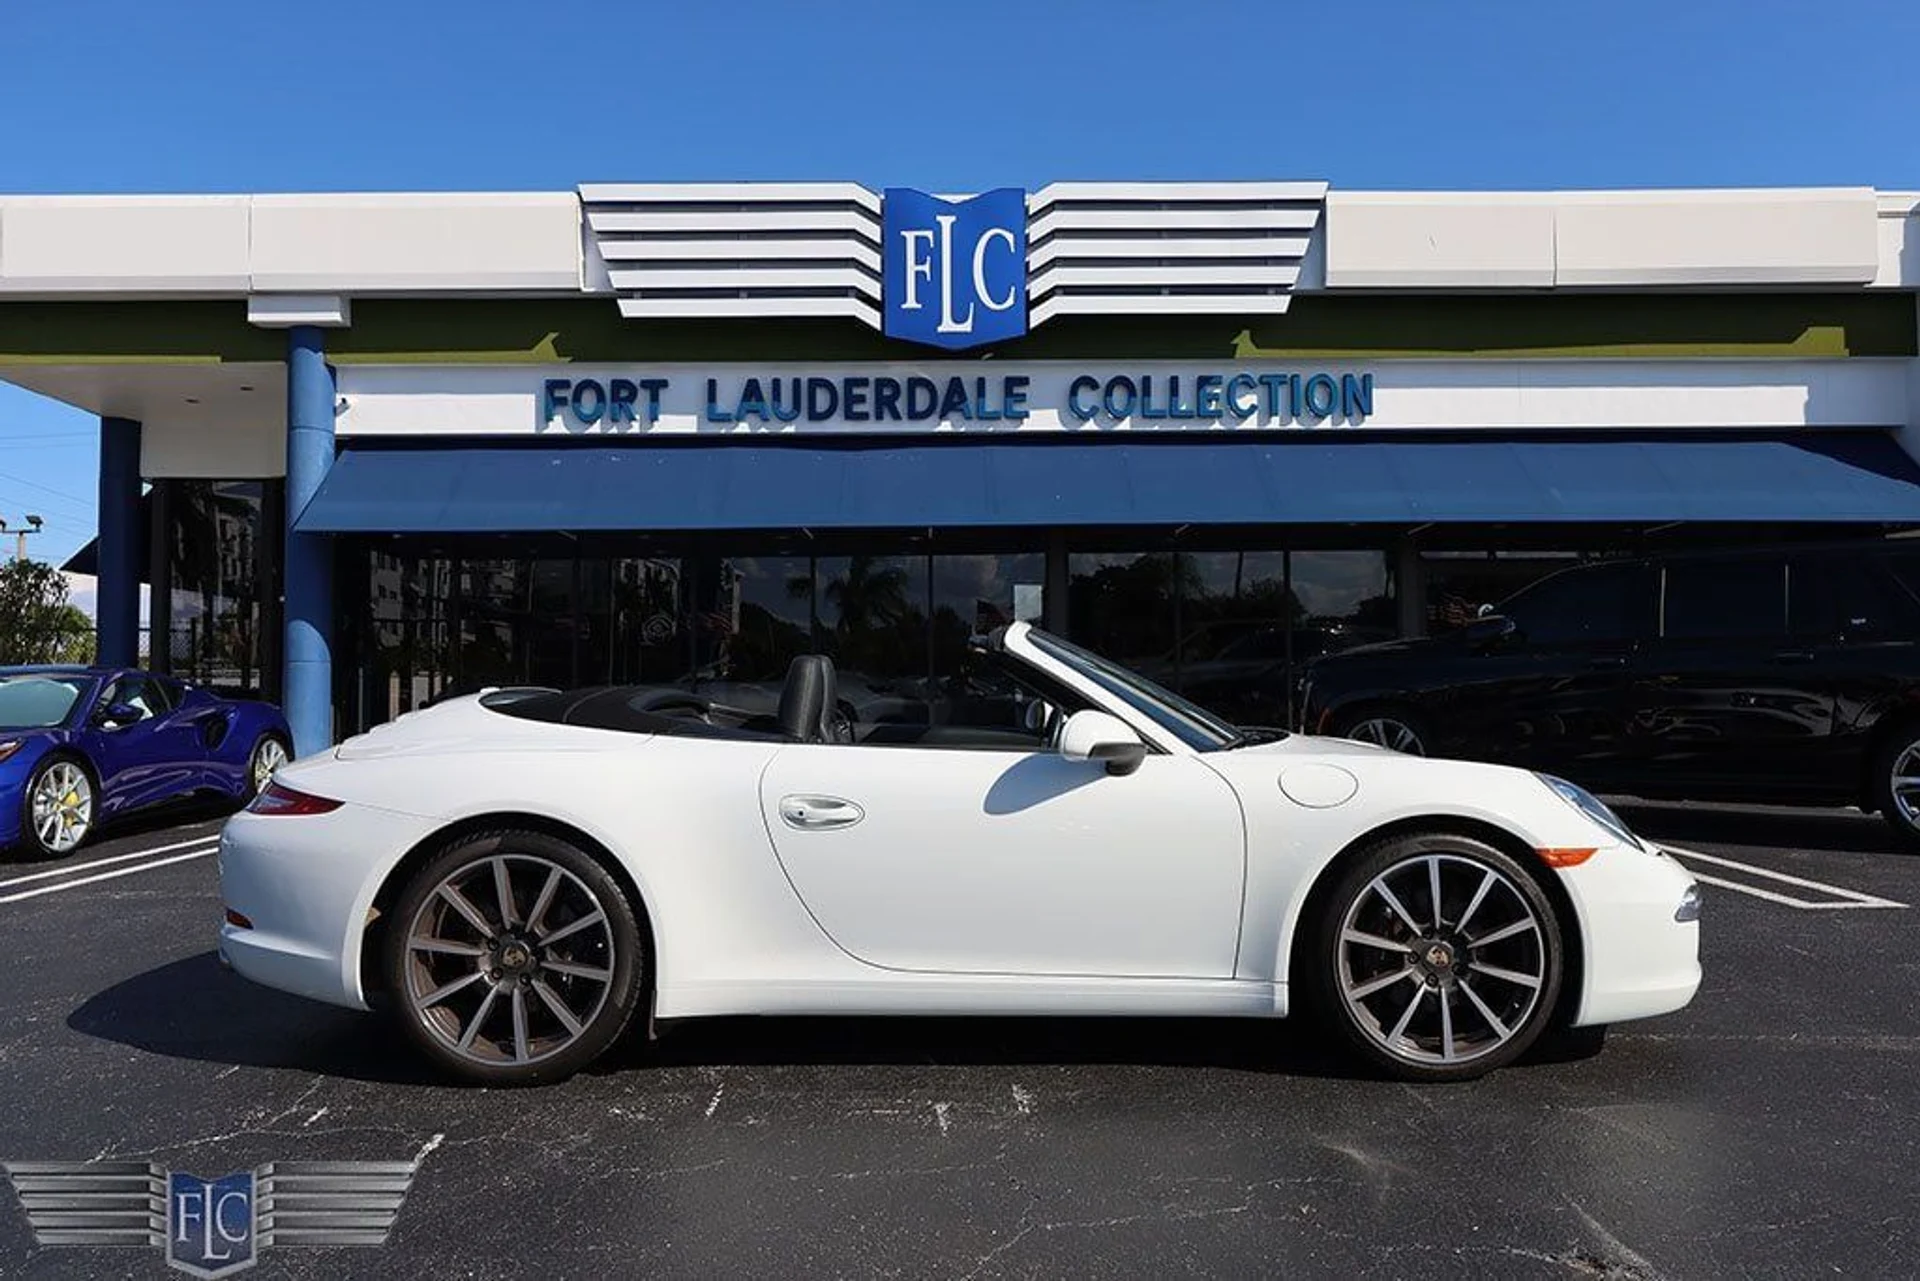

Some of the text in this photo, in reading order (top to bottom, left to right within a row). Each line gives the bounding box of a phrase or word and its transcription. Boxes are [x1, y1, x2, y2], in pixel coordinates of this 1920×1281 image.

[900, 215, 1016, 333] FLC
[544, 373, 1374, 424] FORT LAUDERDALE COLLECTION
